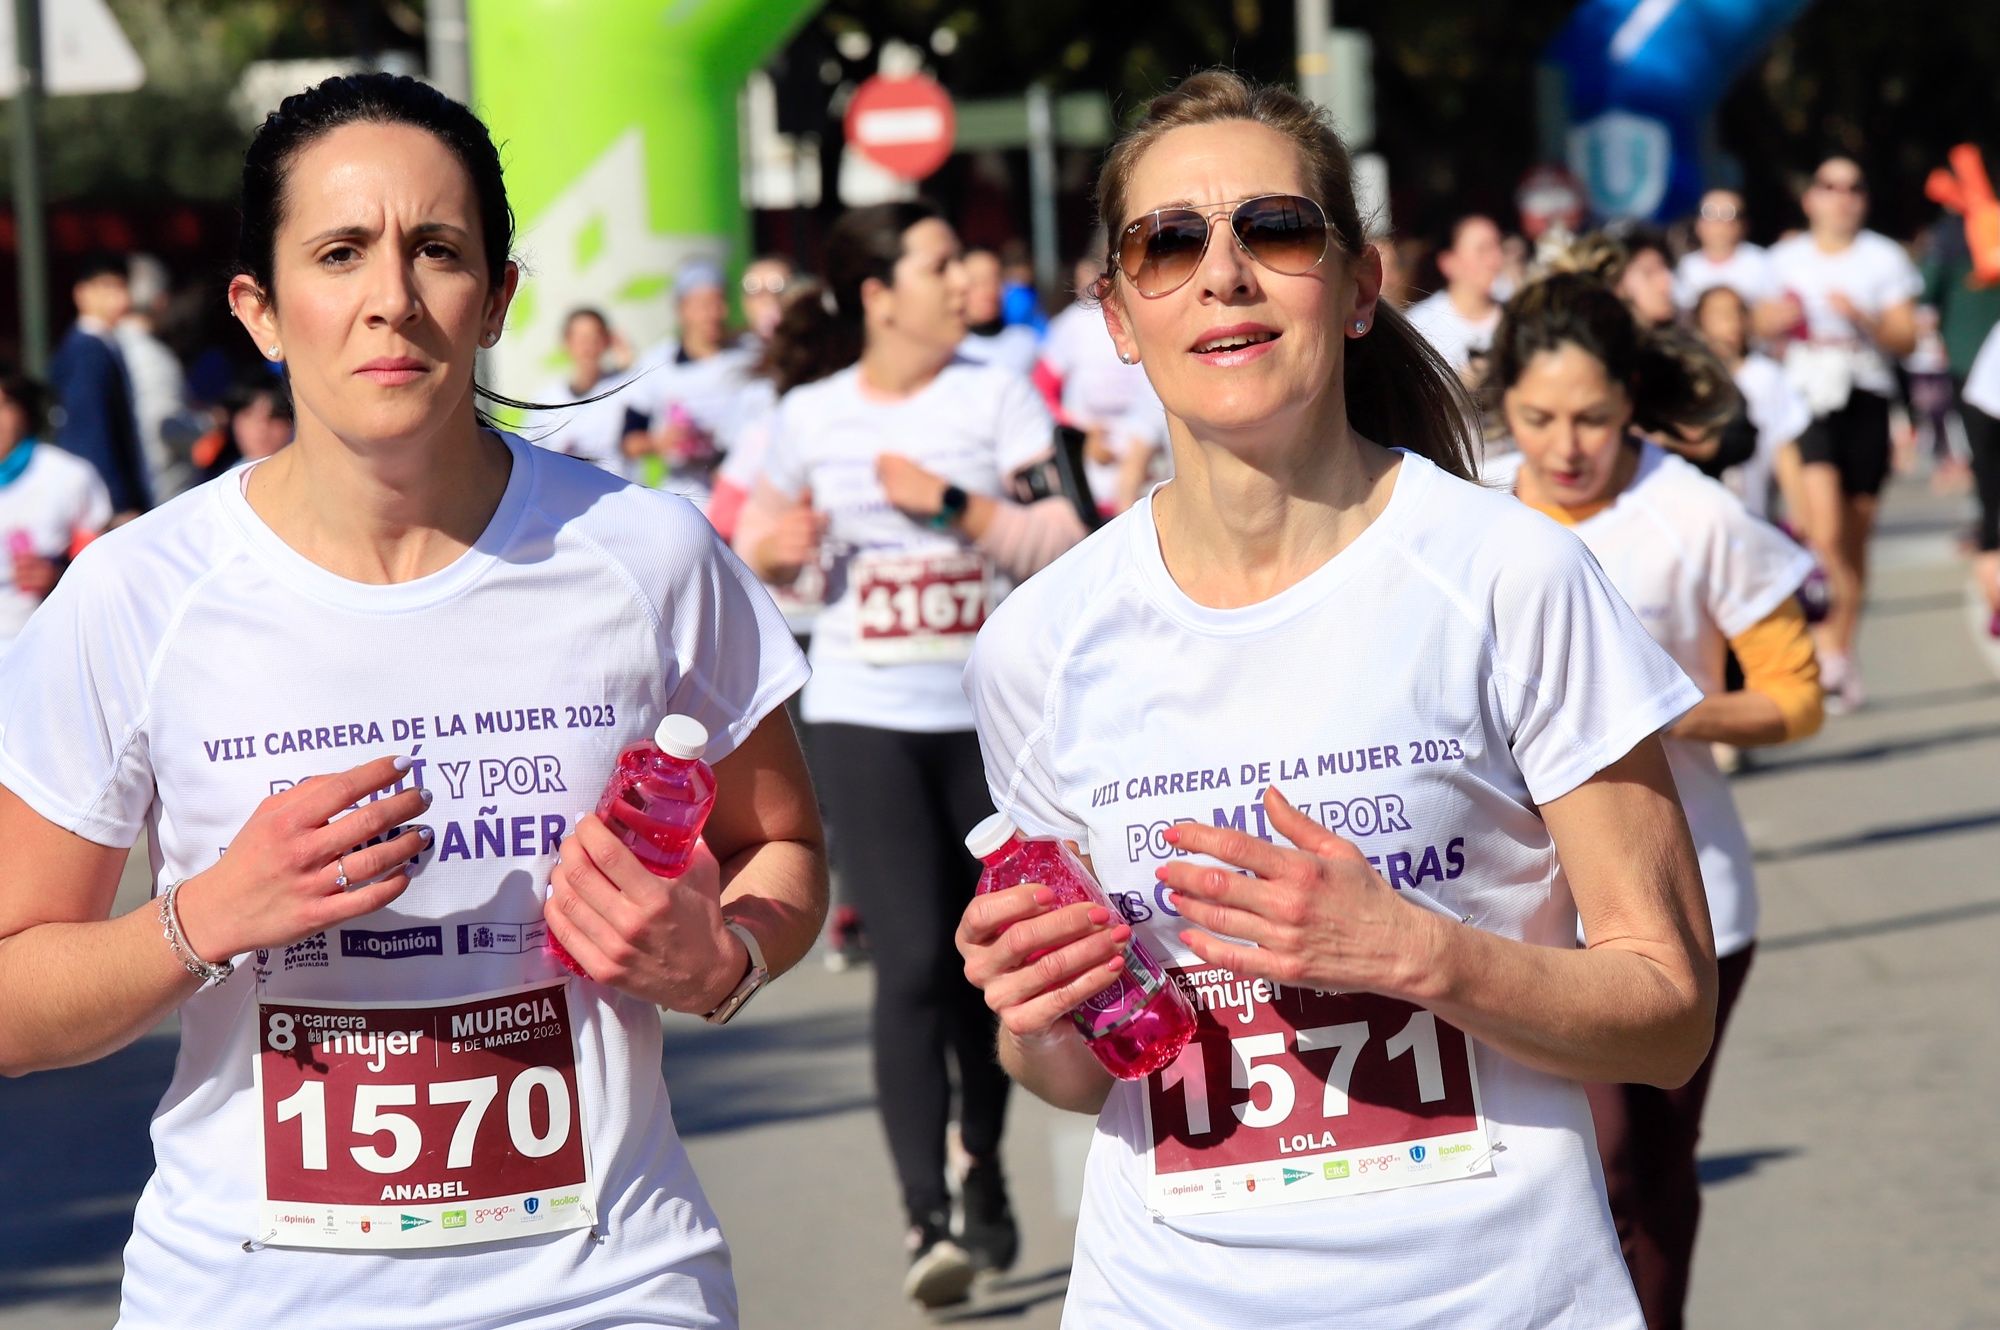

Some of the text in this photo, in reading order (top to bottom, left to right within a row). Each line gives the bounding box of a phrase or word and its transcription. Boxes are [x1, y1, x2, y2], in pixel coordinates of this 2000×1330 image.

[203, 704, 616, 762] VIII CARRERA DE LA MUJER 2023
[437, 760, 471, 800] Y
[479, 755, 568, 797] POR
[1091, 738, 1465, 808] VIII CARRERA DE LA MUJER 2023
[1320, 794, 1412, 837] POR
[284, 950, 329, 966] Murcia
[1175, 967, 1235, 988] carrera
[302, 1013, 367, 1030] carrera
[451, 997, 558, 1039] MURCIA
[322, 1029, 424, 1073] mujer
[451, 1022, 562, 1054] 5 DE MARZO 2023
[1161, 1010, 1446, 1136] 1571
[276, 1065, 571, 1174] 1570
[1278, 1130, 1337, 1154] LOLA
[1438, 1144, 1472, 1157] llaollao
[380, 1180, 469, 1201] ANABEL
[274, 1214, 316, 1225] LaOpinión
